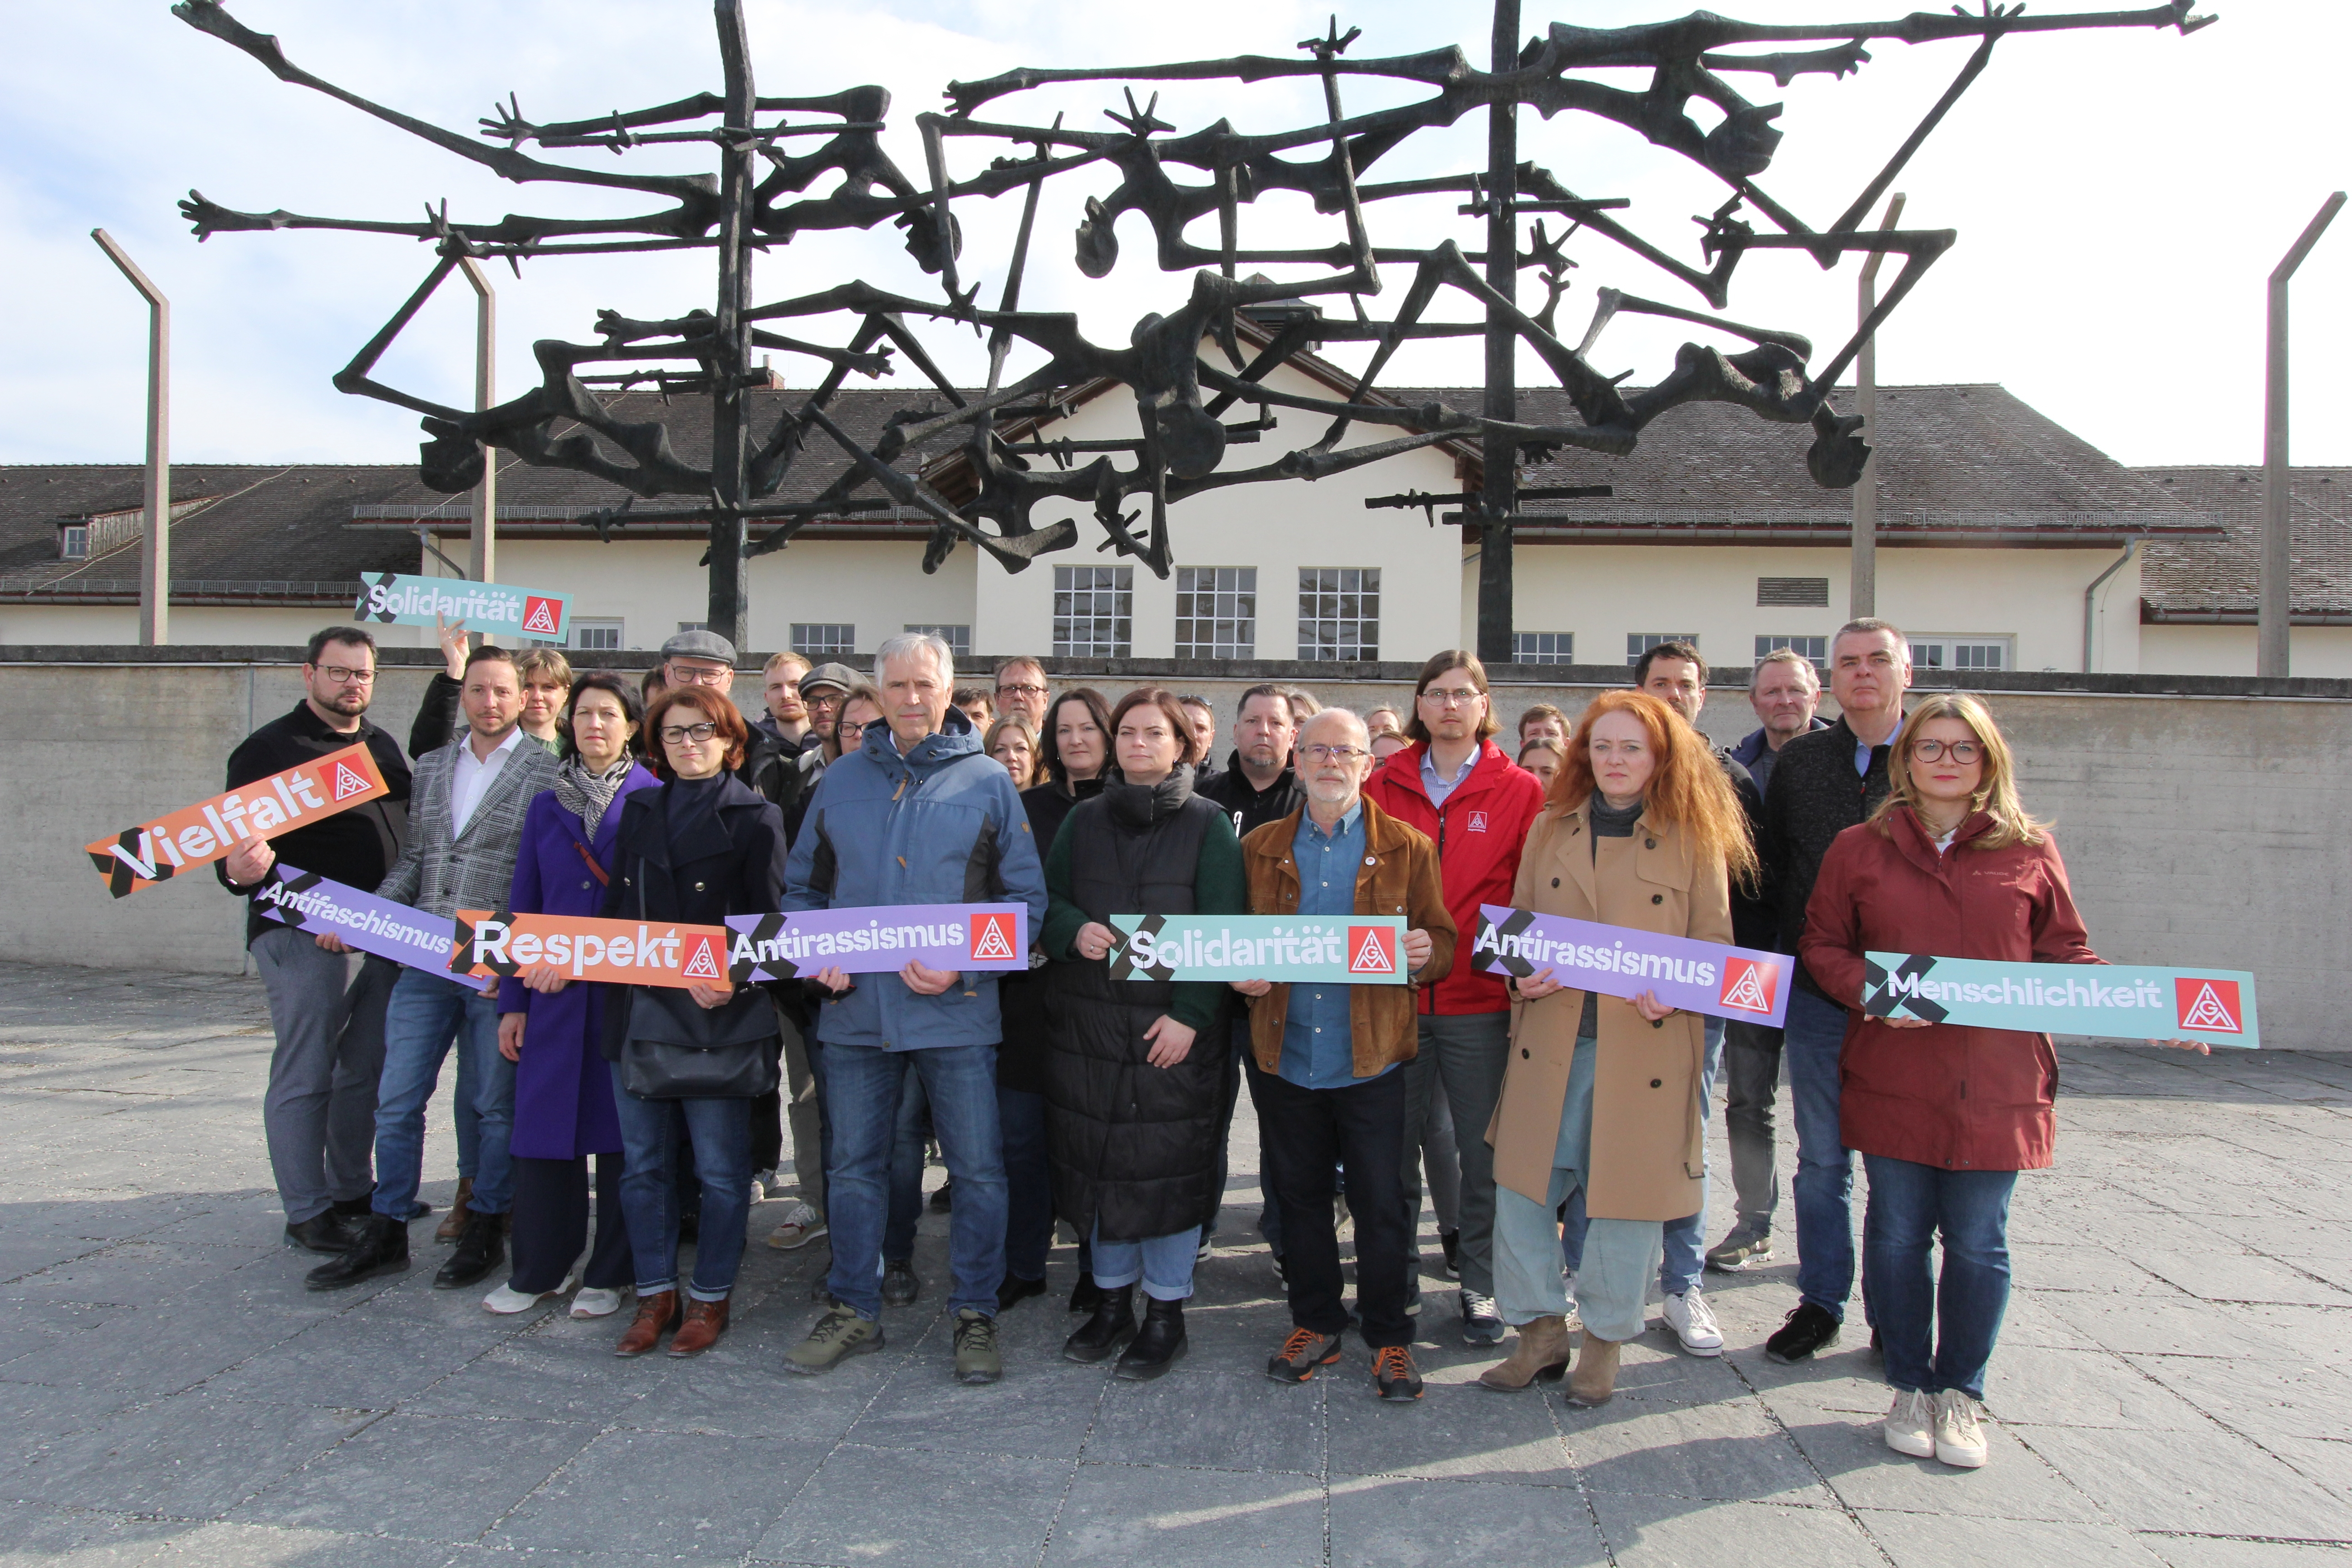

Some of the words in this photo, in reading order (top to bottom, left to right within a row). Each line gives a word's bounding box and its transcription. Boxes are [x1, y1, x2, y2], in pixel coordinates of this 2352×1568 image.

[368, 584, 520, 622] Solidarität
[108, 770, 325, 879] Vielfalt
[260, 881, 451, 954] Antifaschismus
[730, 920, 964, 965] Antirassismus
[473, 921, 681, 976] Respekt
[1129, 925, 1341, 969] Solidarität
[1475, 923, 1715, 987] Antirassismus
[1887, 970, 2162, 1008] Menschlichkeit
